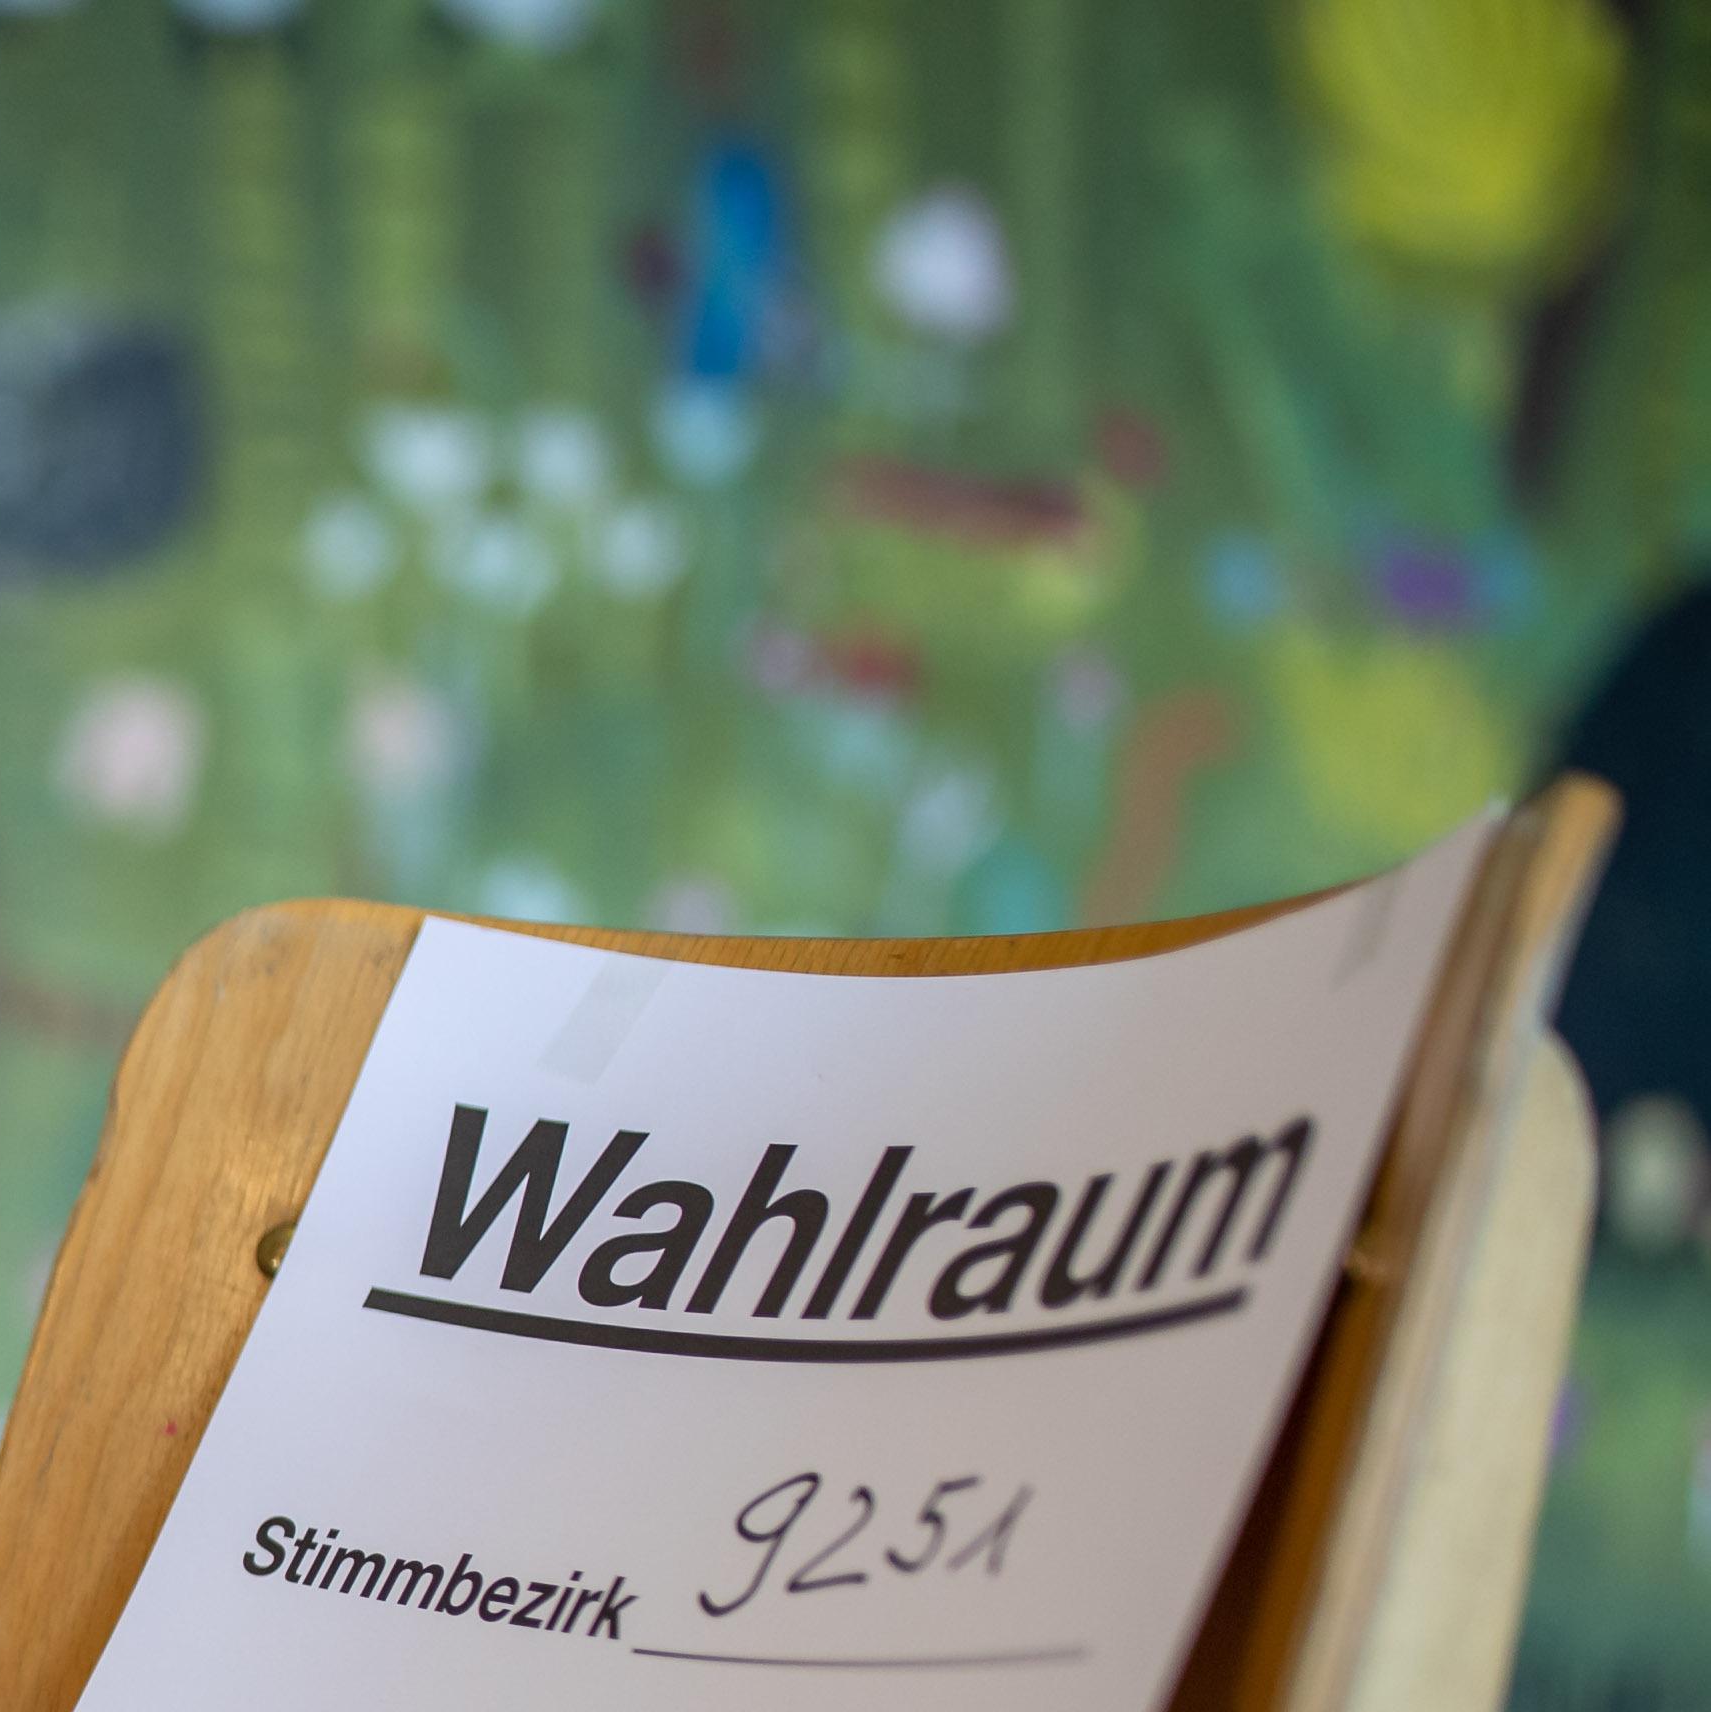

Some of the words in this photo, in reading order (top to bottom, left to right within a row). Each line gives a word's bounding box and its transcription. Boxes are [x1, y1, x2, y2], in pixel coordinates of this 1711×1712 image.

[417, 1103, 1318, 1322] Wahlraum
[241, 1516, 636, 1639] Stimmbezirk
[698, 1471, 1035, 1618] 9251
